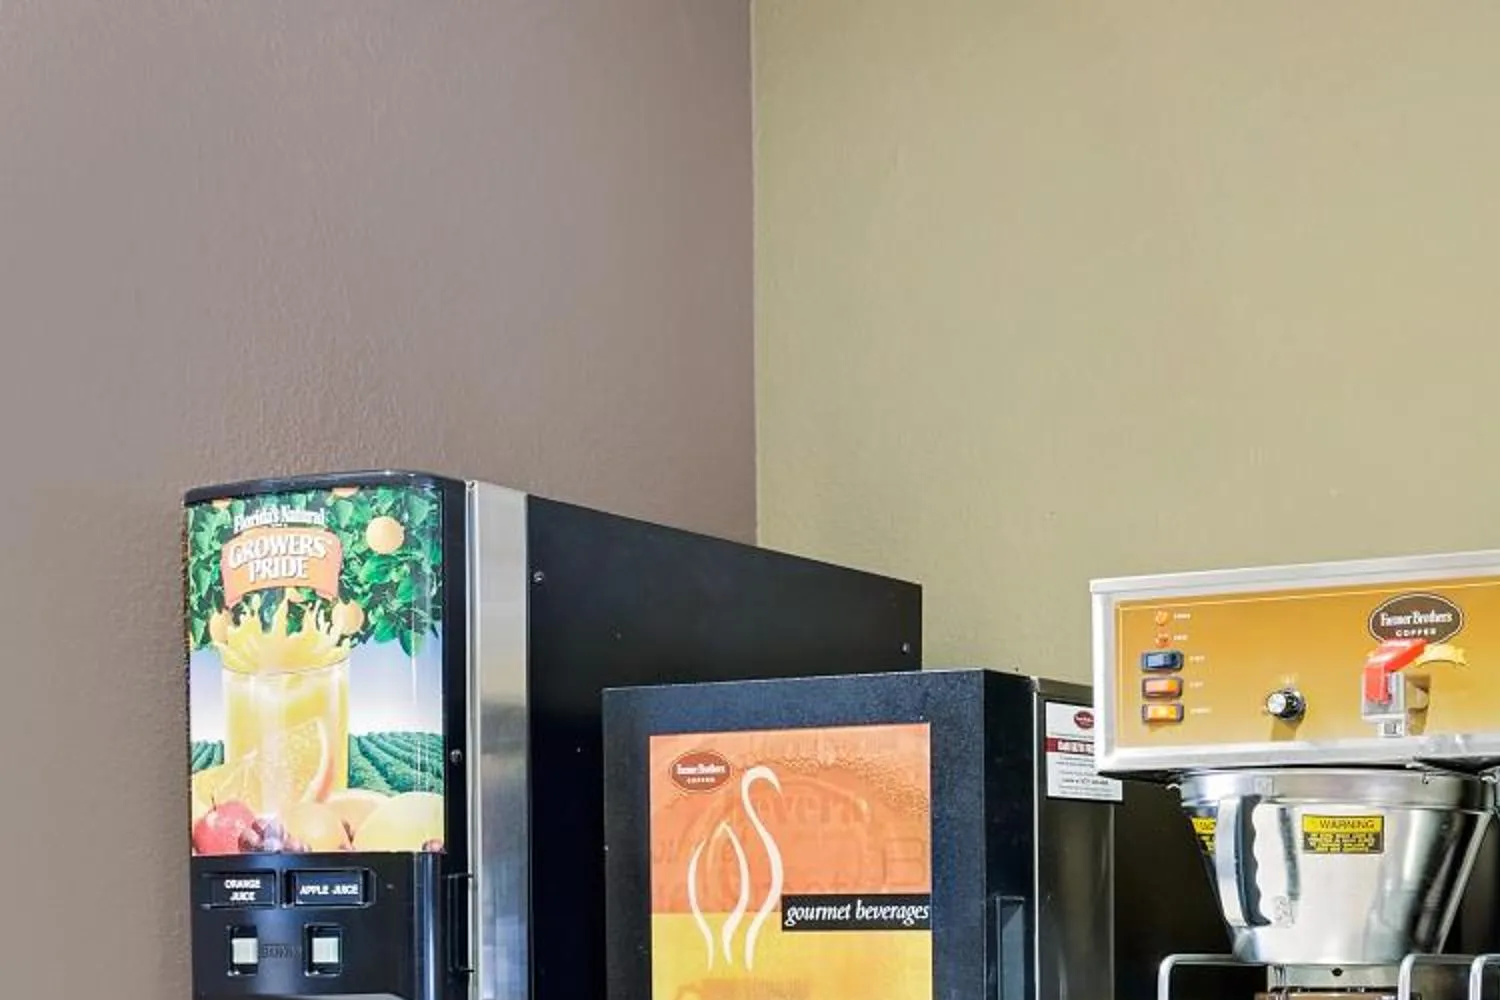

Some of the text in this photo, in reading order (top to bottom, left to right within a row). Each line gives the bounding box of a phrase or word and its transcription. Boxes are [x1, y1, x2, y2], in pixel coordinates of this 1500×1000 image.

[249, 555, 309, 582] PRIDE
[1395, 627, 1437, 637] COFFEE
[224, 879, 262, 889] ORANGE
[299, 884, 360, 896] APPLE JUICE
[229, 891, 256, 901] JUICE
[784, 899, 930, 926] gourmet beverages
